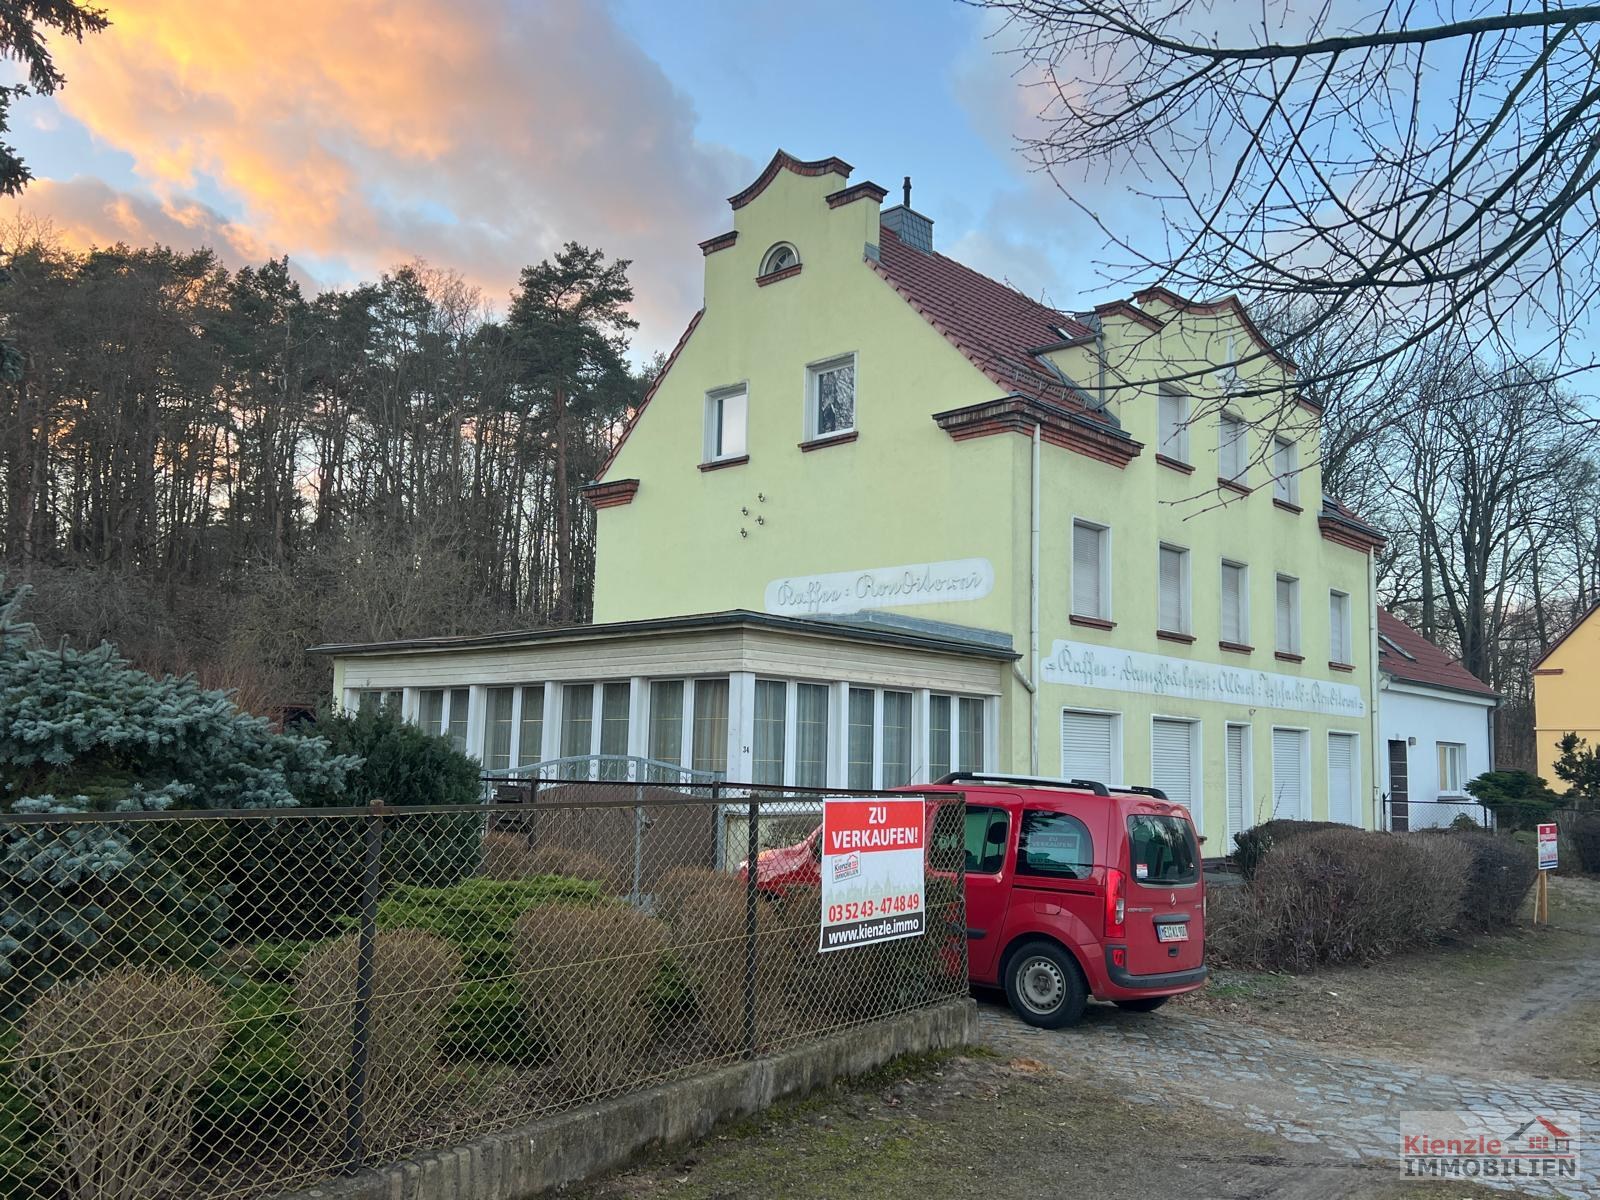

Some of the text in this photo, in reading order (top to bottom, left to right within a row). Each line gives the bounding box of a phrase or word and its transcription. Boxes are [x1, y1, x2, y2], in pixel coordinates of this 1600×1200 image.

[742, 746, 749, 754] 34
[868, 806, 886, 824] ZU
[831, 827, 918, 849] VERKAUFEN!
[828, 918, 919, 945] www.kienzle.immo
